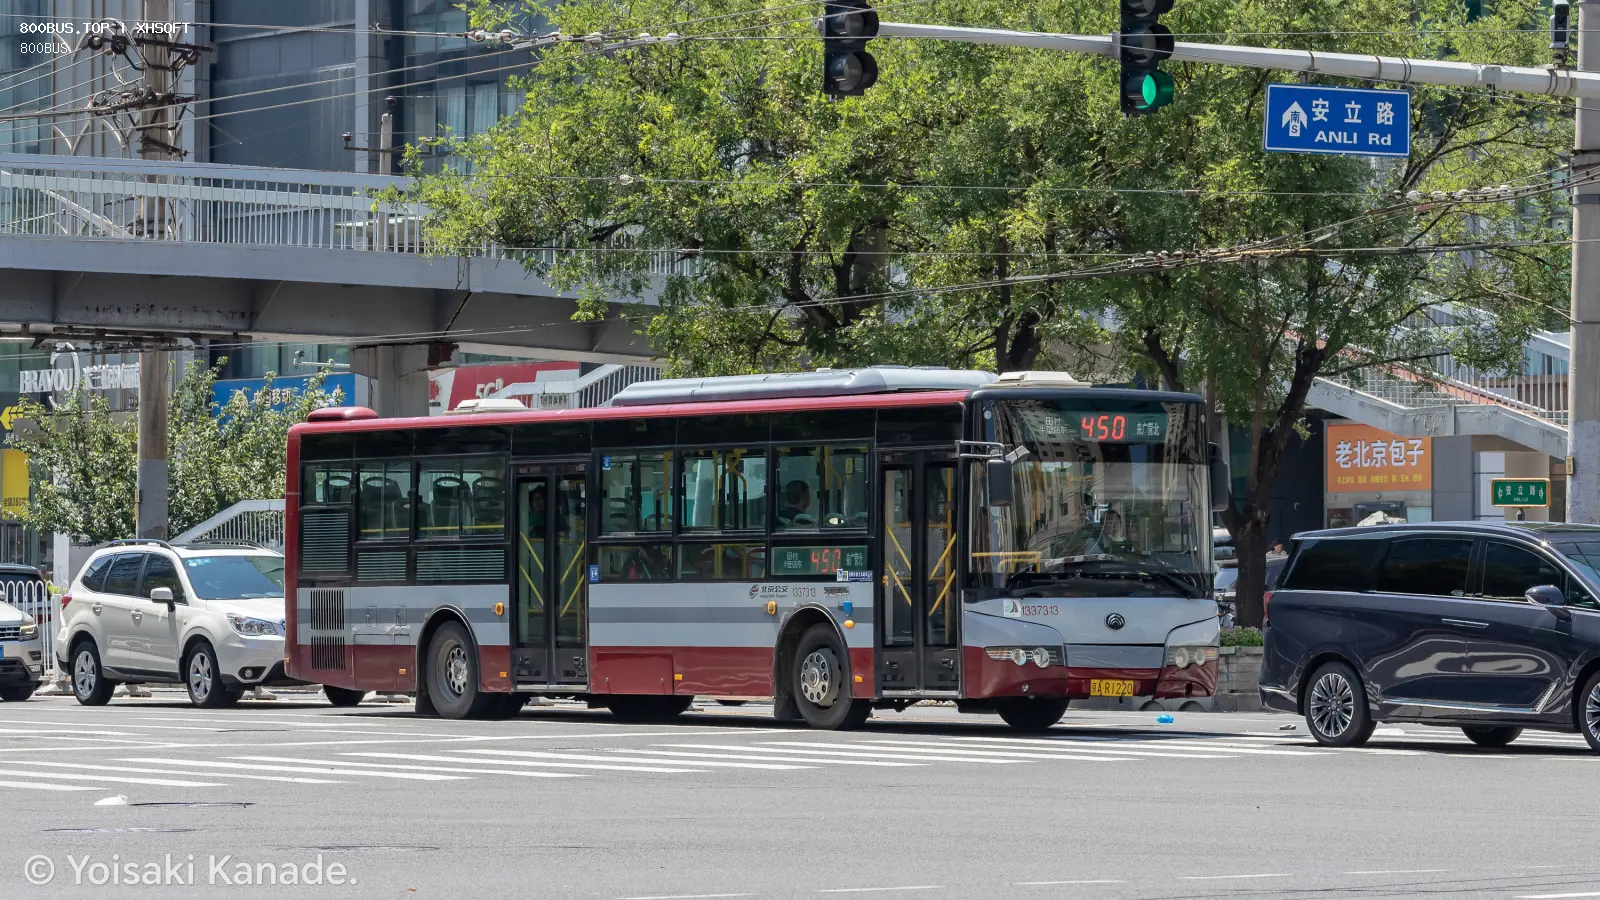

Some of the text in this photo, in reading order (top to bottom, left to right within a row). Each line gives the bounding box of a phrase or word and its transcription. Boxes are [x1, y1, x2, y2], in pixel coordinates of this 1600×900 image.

[1290, 110, 1300, 124] 南
[1311, 97, 1394, 125] 安立路
[1291, 125, 1298, 133] S
[1315, 130, 1391, 146] ANLI Rd
[1045, 416, 1061, 426] 田村
[1081, 415, 1125, 440] 450
[1136, 421, 1160, 436] 来广营北
[1335, 438, 1425, 468] 老北京包子
[811, 549, 841, 573] 450
[760, 585, 789, 593] 北京公交
[792, 587, 816, 598] 1337313
[1021, 605, 1059, 616] 1337313
